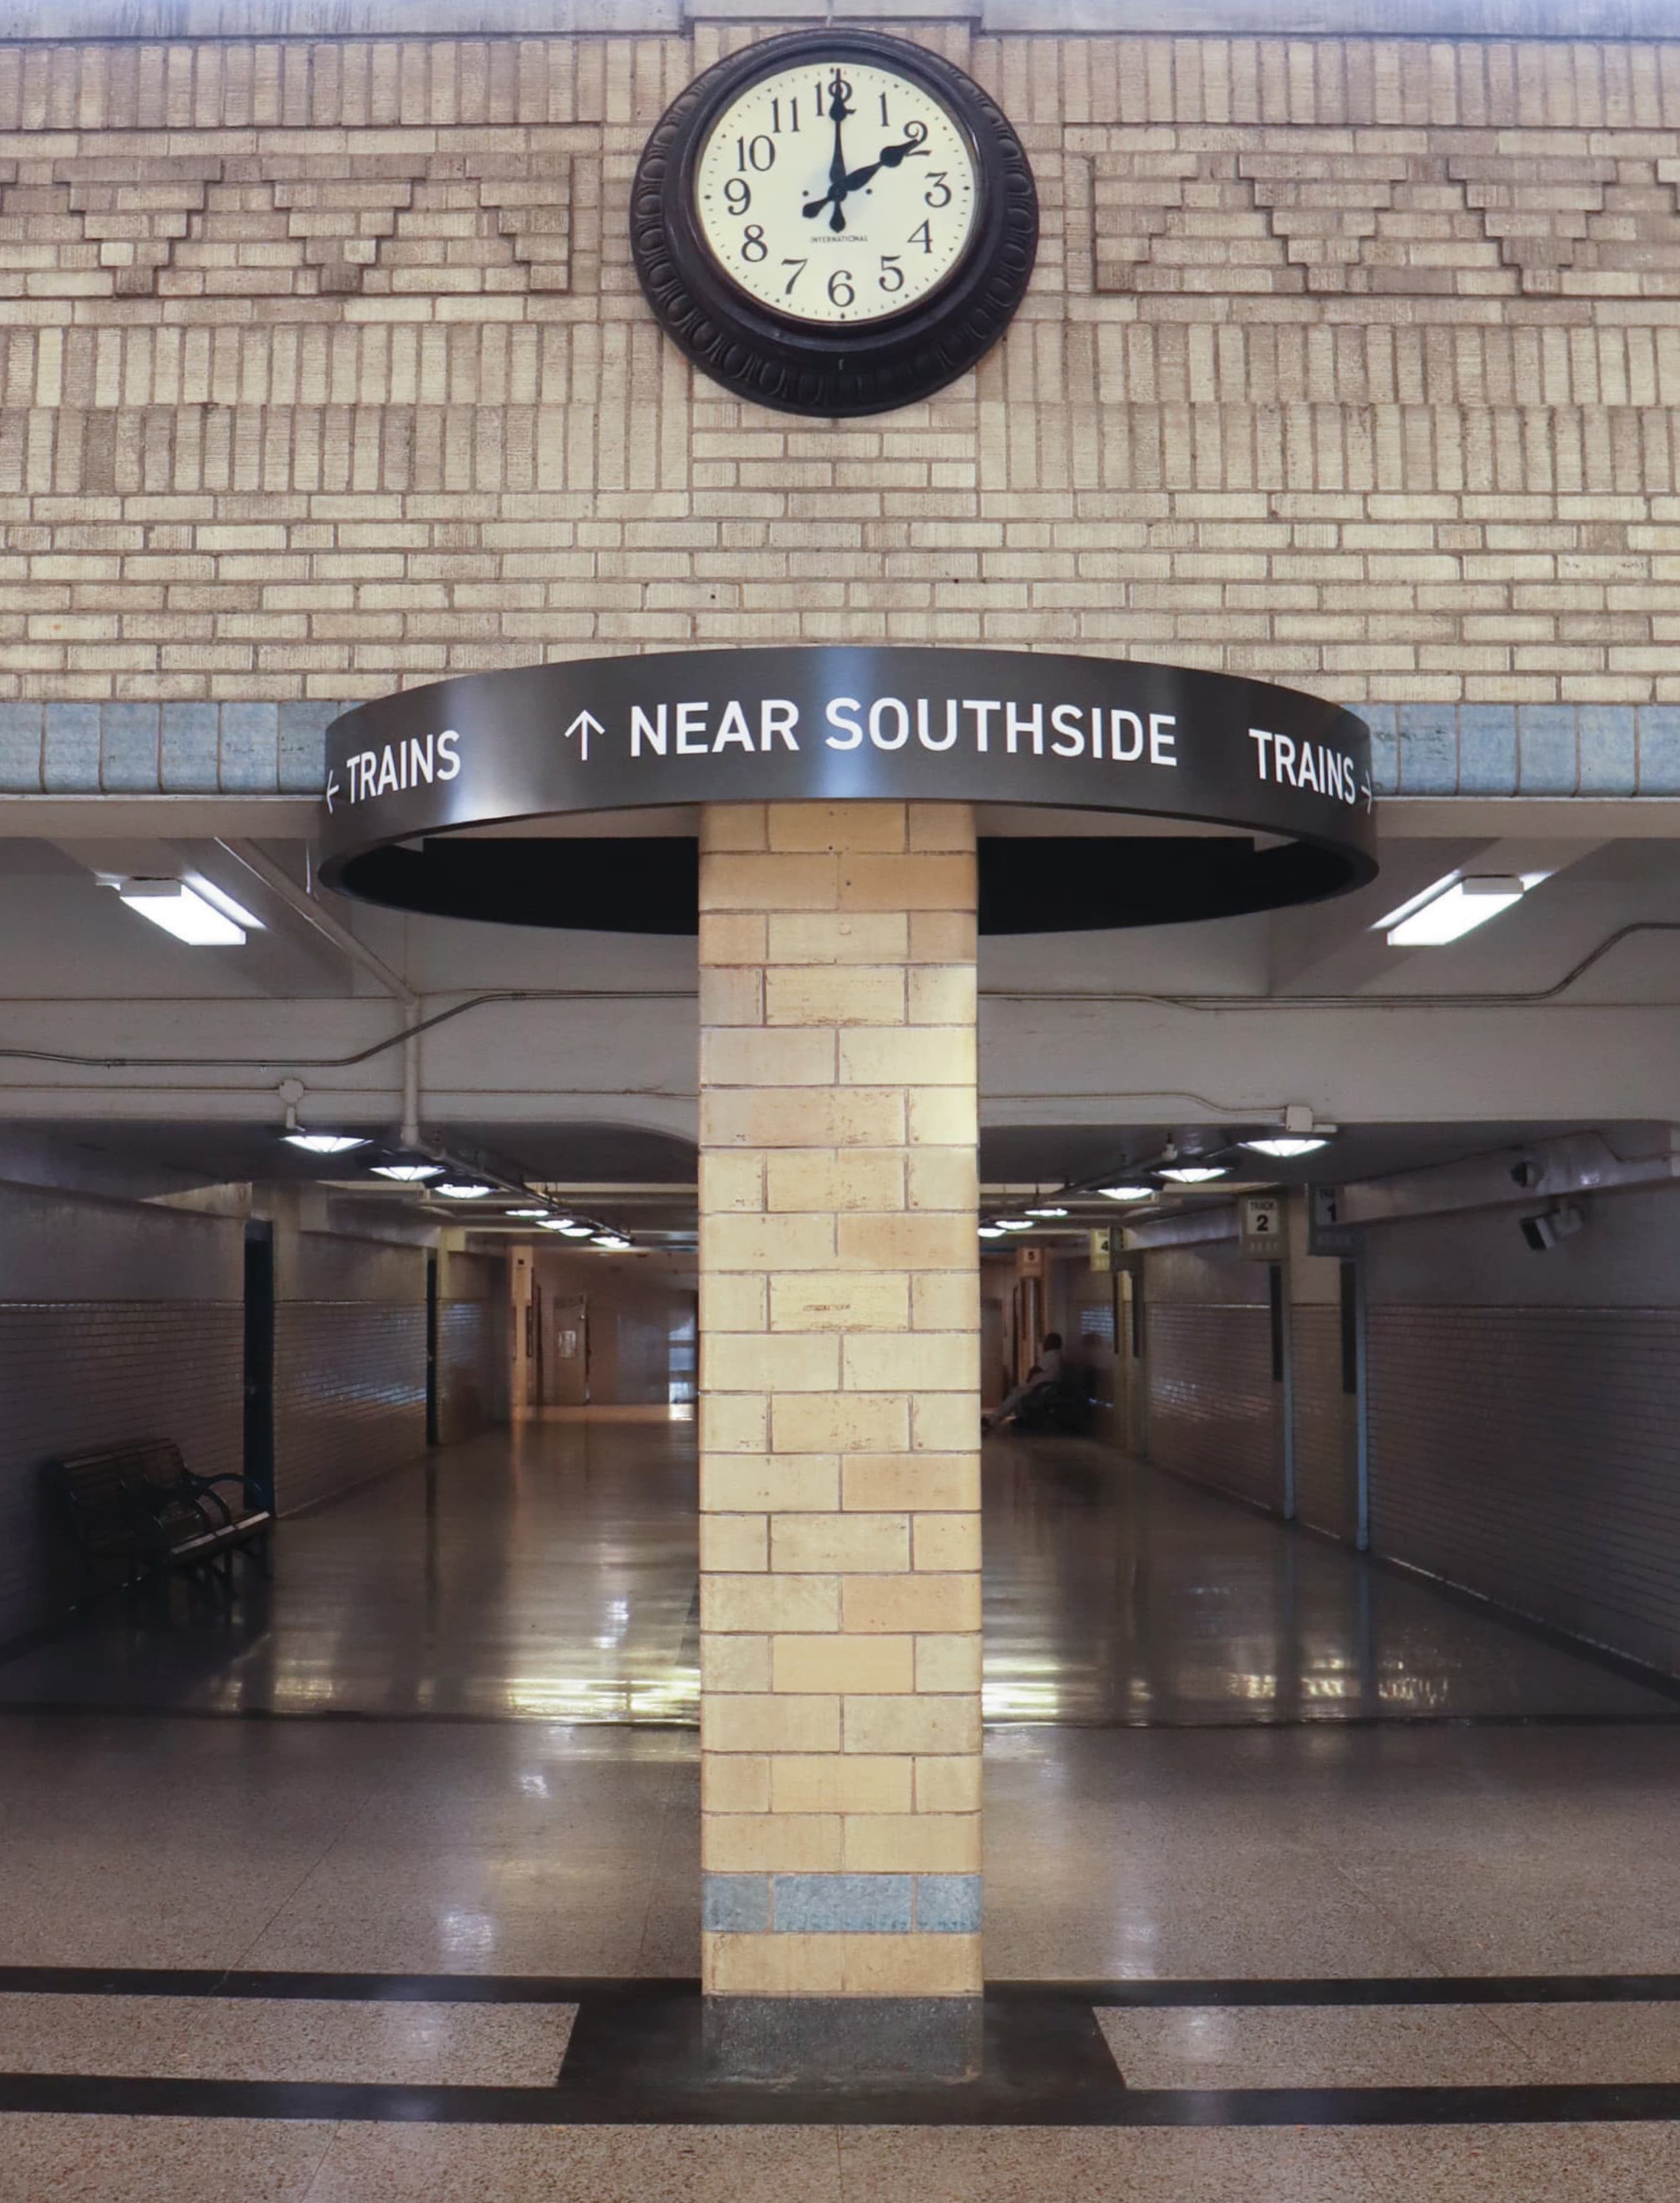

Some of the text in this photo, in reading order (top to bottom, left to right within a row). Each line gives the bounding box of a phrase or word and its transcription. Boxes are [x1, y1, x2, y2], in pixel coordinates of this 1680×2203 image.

[771, 97, 801, 133] 11
[879, 91, 890, 127] 1
[737, 135, 775, 172] 10
[903, 120, 932, 157] 2
[724, 178, 751, 216] 9
[924, 172, 952, 208] 3
[741, 225, 767, 263] 8
[907, 219, 932, 254] 4
[781, 259, 807, 295] 7
[827, 270, 855, 307] 6
[878, 255, 904, 292] 5
[631, 697, 1176, 766] NEAR SOUTHSIDE
[346, 730, 461, 803] TRAINS
[1249, 729, 1355, 804] TRAINS
[1256, 1214, 1269, 1231] 2
[1326, 1203, 1337, 1222] 1
